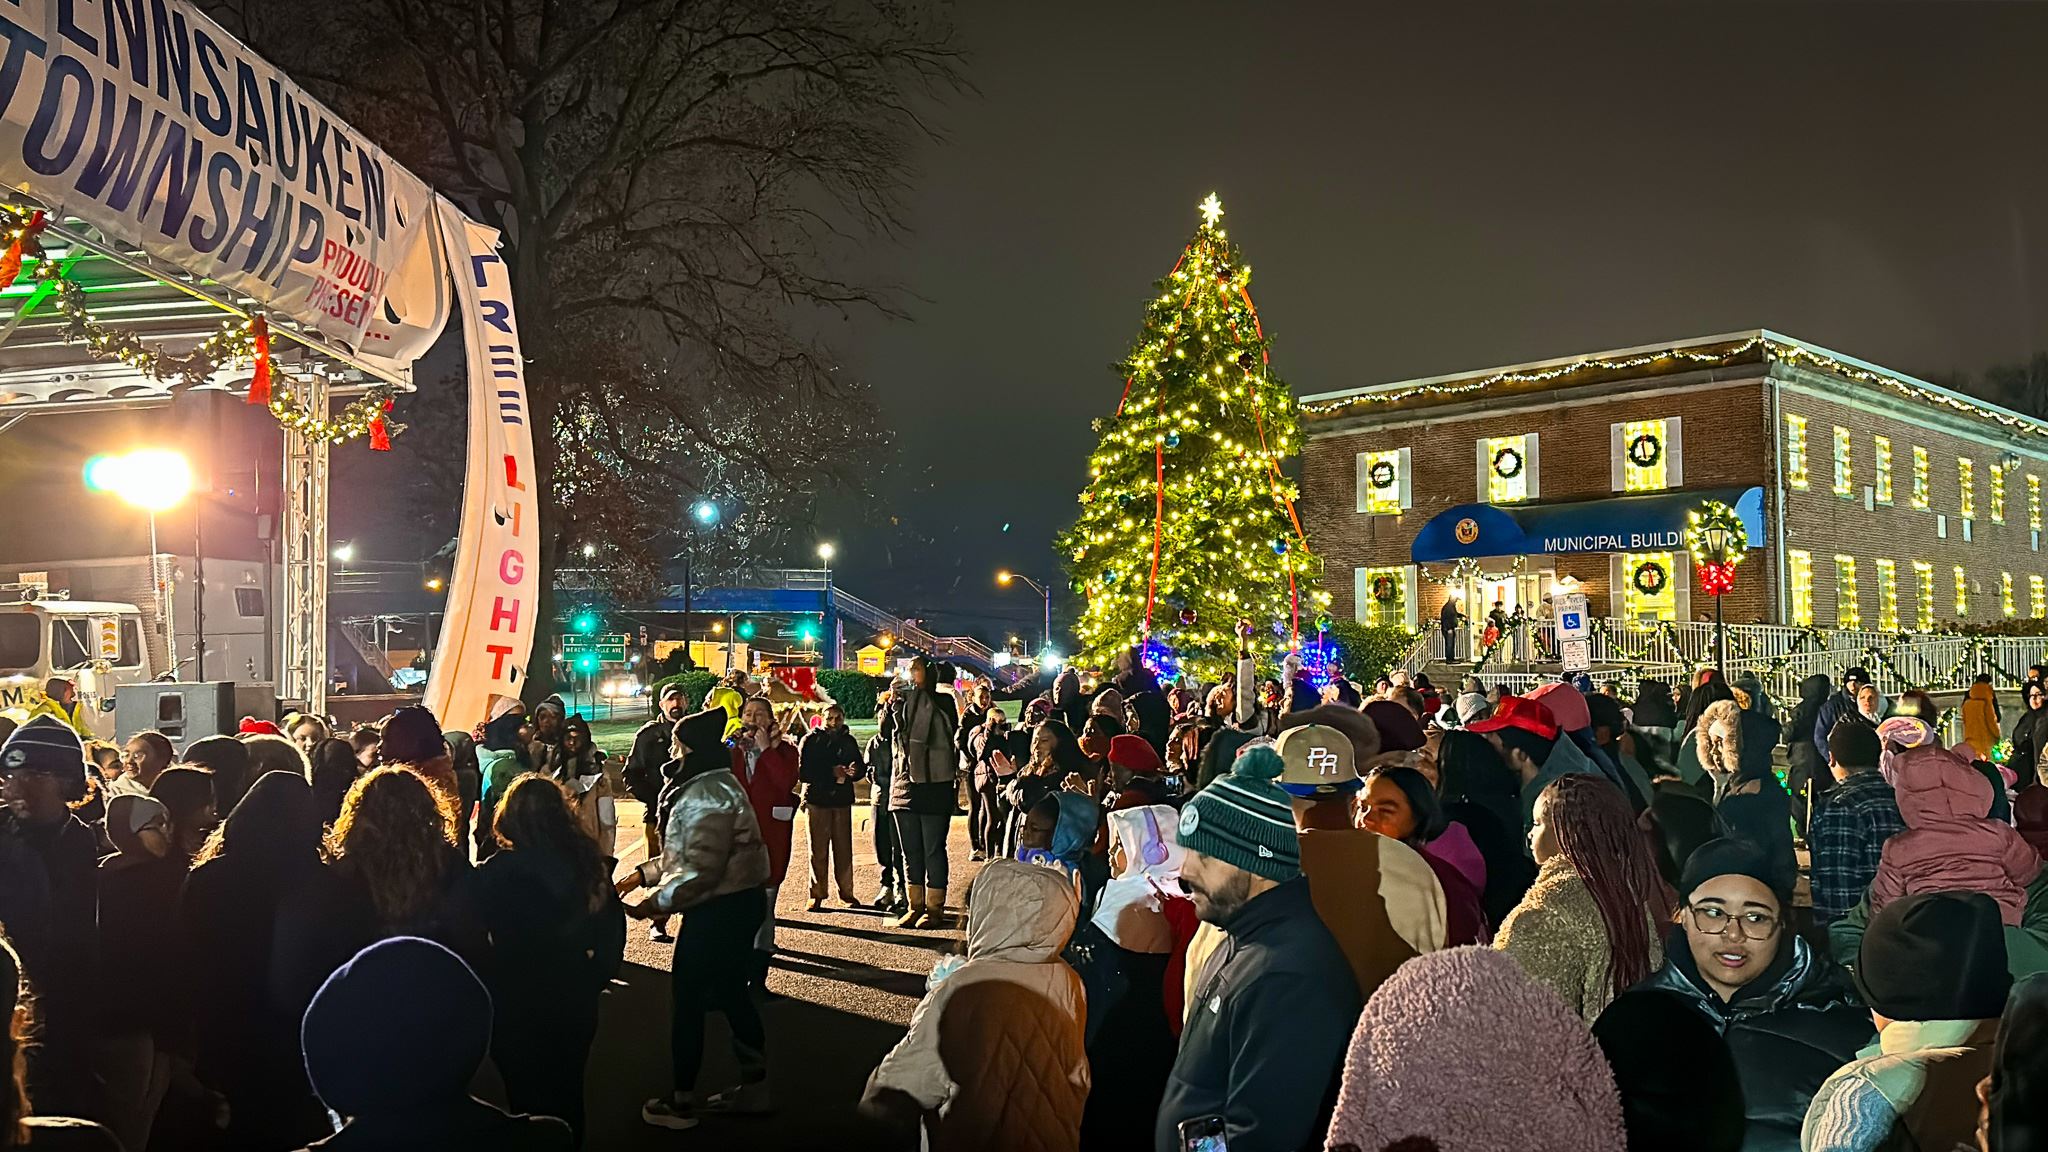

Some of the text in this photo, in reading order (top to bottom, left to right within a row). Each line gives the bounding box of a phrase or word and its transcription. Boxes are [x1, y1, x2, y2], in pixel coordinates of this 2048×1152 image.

[0, 0, 385, 241] ENNSAUKEN
[471, 254, 526, 680] TREE LIGHT
[1544, 531, 1706, 552] MUNICIPAL BUILDI
